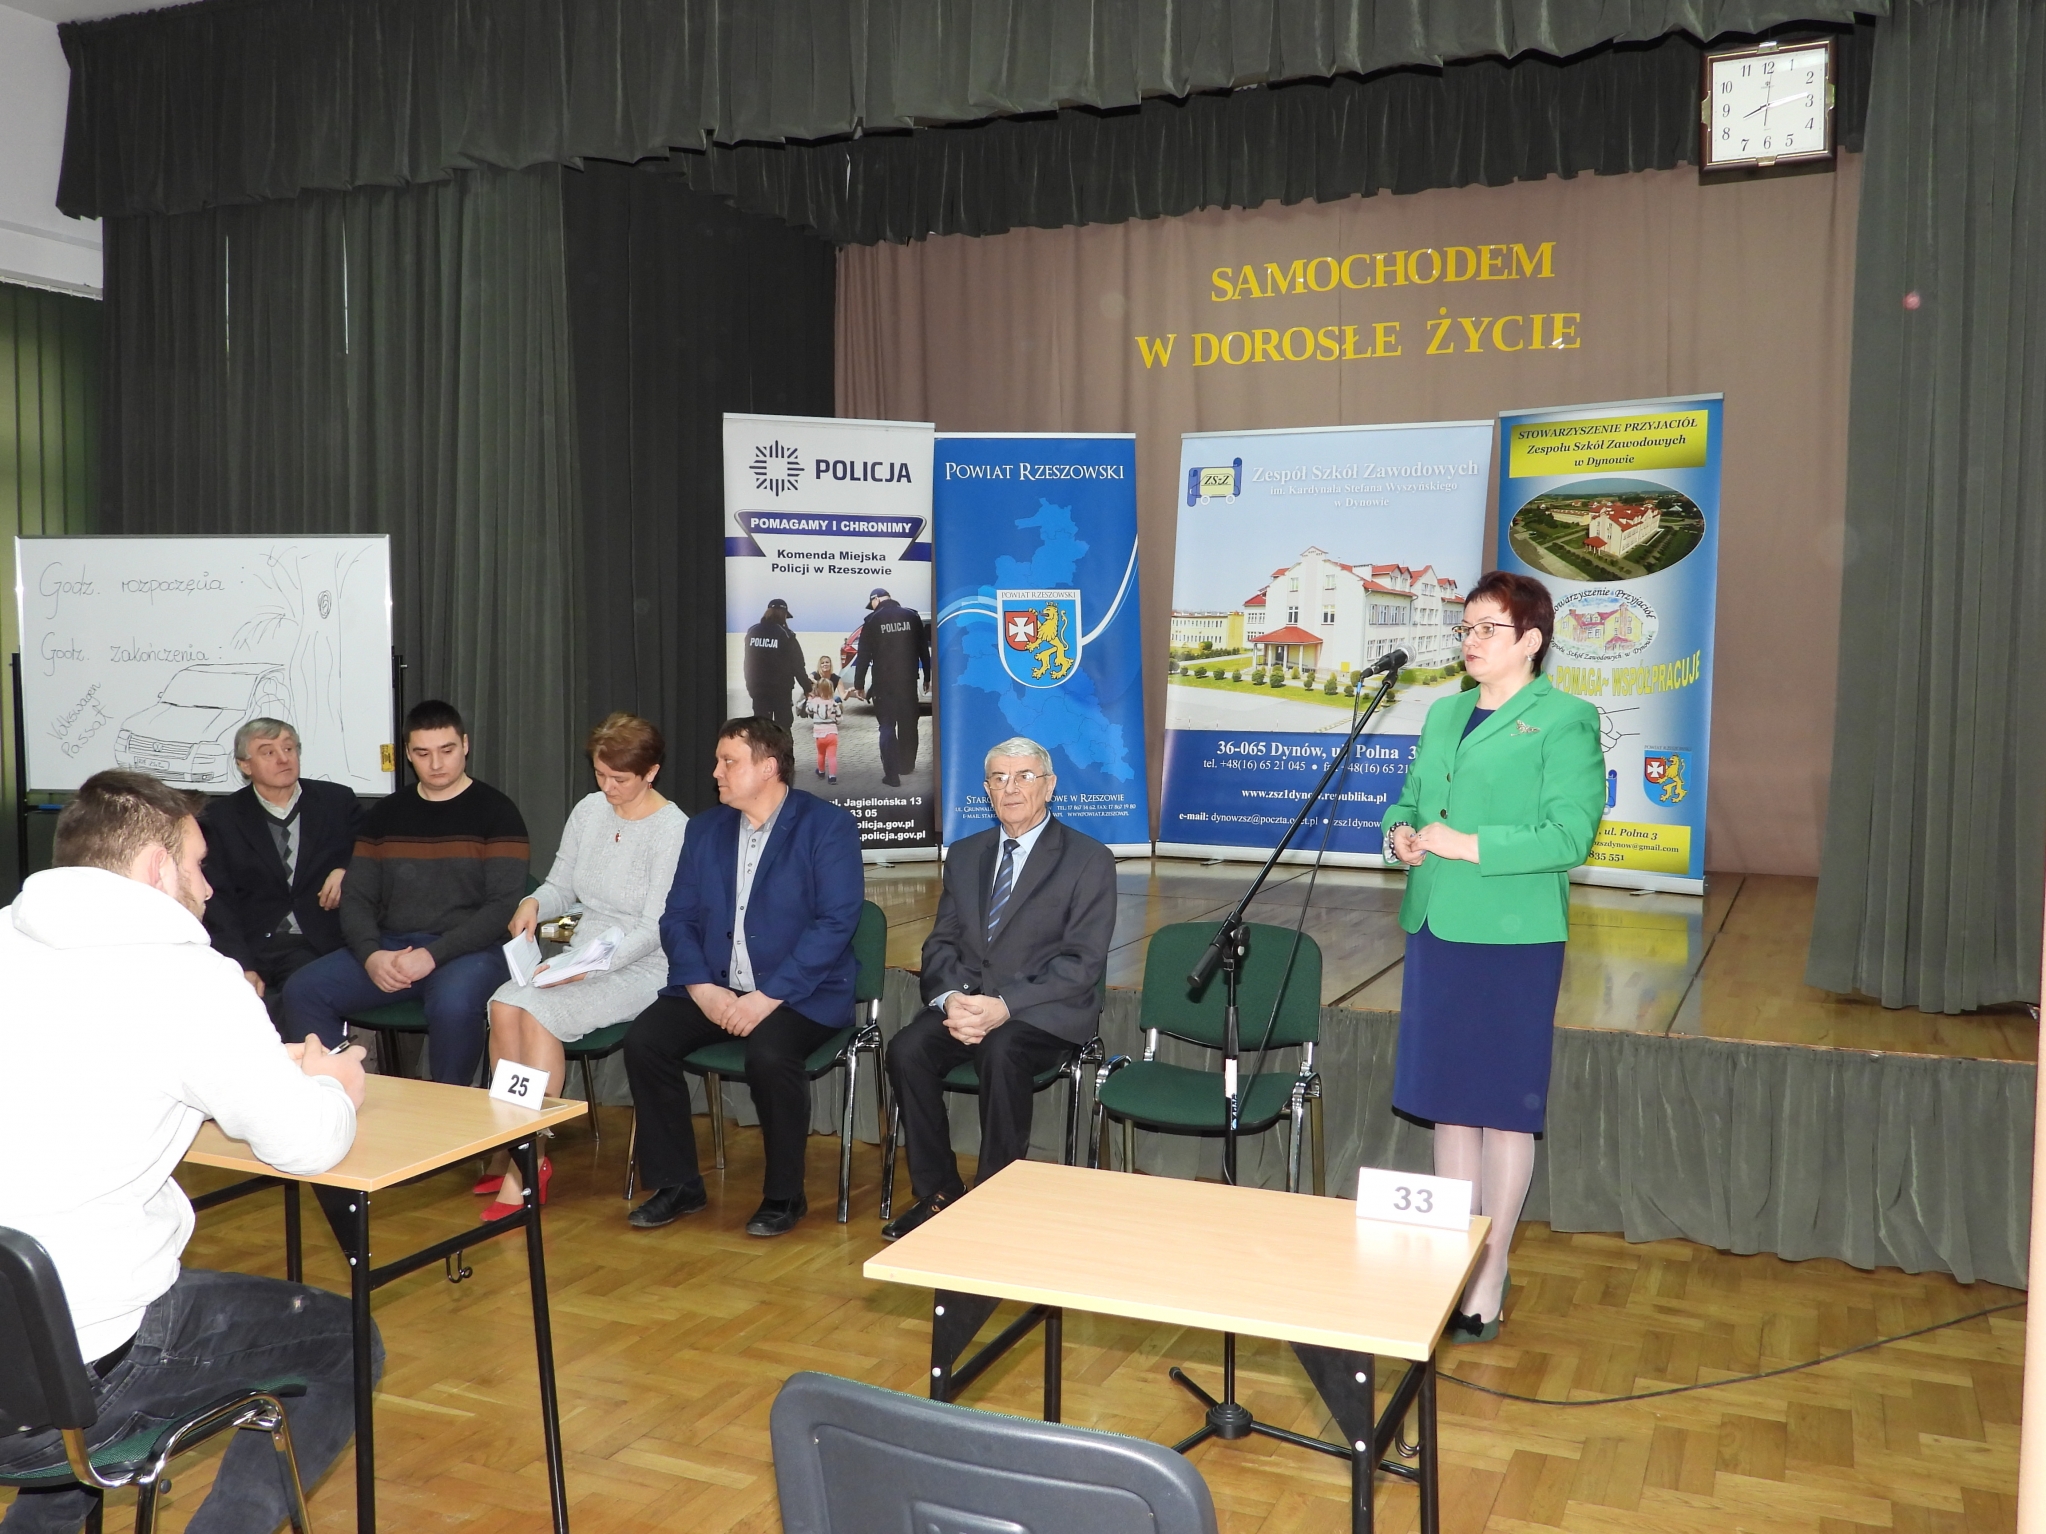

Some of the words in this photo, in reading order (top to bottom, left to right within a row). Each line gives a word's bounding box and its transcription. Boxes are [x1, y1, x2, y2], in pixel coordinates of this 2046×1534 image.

[1741, 64, 1752, 77] 11
[1762, 61, 1775, 74] 12
[1789, 58, 1794, 71] 1
[1806, 71, 1814, 84] 2
[1721, 80, 1733, 94] 10
[1805, 94, 1814, 107] 3
[1722, 104, 1730, 117] 9
[1805, 117, 1814, 130] 4
[1722, 127, 1730, 140] 8
[1785, 133, 1794, 147] 5
[1741, 138, 1750, 152] 7
[1763, 135, 1772, 149] 6
[1211, 241, 1556, 302] SAMOCHODEM
[1135, 333, 1177, 369] W
[1192, 321, 1402, 367] DOROSŁE
[1426, 307, 1581, 355] ŻYCIE
[1518, 423, 1622, 439] STOWARZYSZENIE
[1624, 415, 1698, 432] PRZYJACIÓŁ
[1527, 442, 1571, 455] Zespołu
[1573, 439, 1604, 452] Szkół
[1606, 434, 1686, 450] Zawodowych
[1574, 458, 1584, 467] w
[1586, 455, 1635, 467] Dynowie
[815, 459, 912, 484] POLICJA
[945, 462, 1013, 480] POWIAT
[1019, 462, 1124, 481] RZESZOWSKI
[1252, 465, 1307, 484] Zespół
[1311, 463, 1359, 481] Szkół
[1363, 459, 1479, 480] Zawodowych
[1270, 485, 1286, 495] im.
[1289, 482, 1341, 497] Kardynała
[1344, 481, 1383, 493] Stefana
[1385, 479, 1458, 494] Wyszyńskiego
[1334, 499, 1342, 507] w
[1345, 497, 1390, 509] Dynowie
[750, 517, 828, 531] POMAGAMY
[832, 520, 837, 531] I
[840, 521, 912, 533] CHRONIMY
[777, 549, 836, 560] Komenda
[839, 551, 887, 562] Miejska
[771, 563, 810, 576] Policji
[813, 566, 825, 574] w
[828, 564, 893, 576] Rzeszowie
[39, 561, 101, 620] Godz.
[1001, 591, 1029, 599] POWIAT
[1031, 591, 1076, 599] RZESZOWSKI
[1553, 587, 1611, 615] owarzyszenie
[881, 621, 911, 634] POLICJA
[749, 637, 779, 649] POLICJA
[40, 631, 90, 677] Godz.
[1612, 649, 1701, 697] WSPÓŁPRACUJE
[45, 682, 101, 740] Volkswagen
[61, 704, 114, 759] Passat
[1217, 741, 1267, 756] 36-065
[1270, 742, 1327, 760] Dynów,
[1356, 744, 1399, 759] Polna
[1408, 745, 1416, 760] 3
[1203, 759, 1218, 768] tel.
[1220, 759, 1257, 771] +48(16)
[1260, 761, 1271, 770] 65
[1274, 761, 1285, 770] 21
[1288, 761, 1306, 771] 045
[1382, 764, 1394, 773] 65
[844, 797, 907, 808] Jagiellońska
[910, 796, 922, 805] 13
[1080, 794, 1125, 802] RZESZOWIE
[865, 809, 878, 817] 05
[1179, 812, 1209, 821] e-mail:
[1210, 812, 1318, 826] dynowzsz@poczta.oet.pl
[1604, 828, 1617, 836] ul.
[1620, 828, 1649, 838] Polna
[1650, 832, 1658, 841] 3
[1608, 853, 1625, 862] 551
[507, 1074, 530, 1097] 25
[1393, 1186, 1434, 1214] 33
